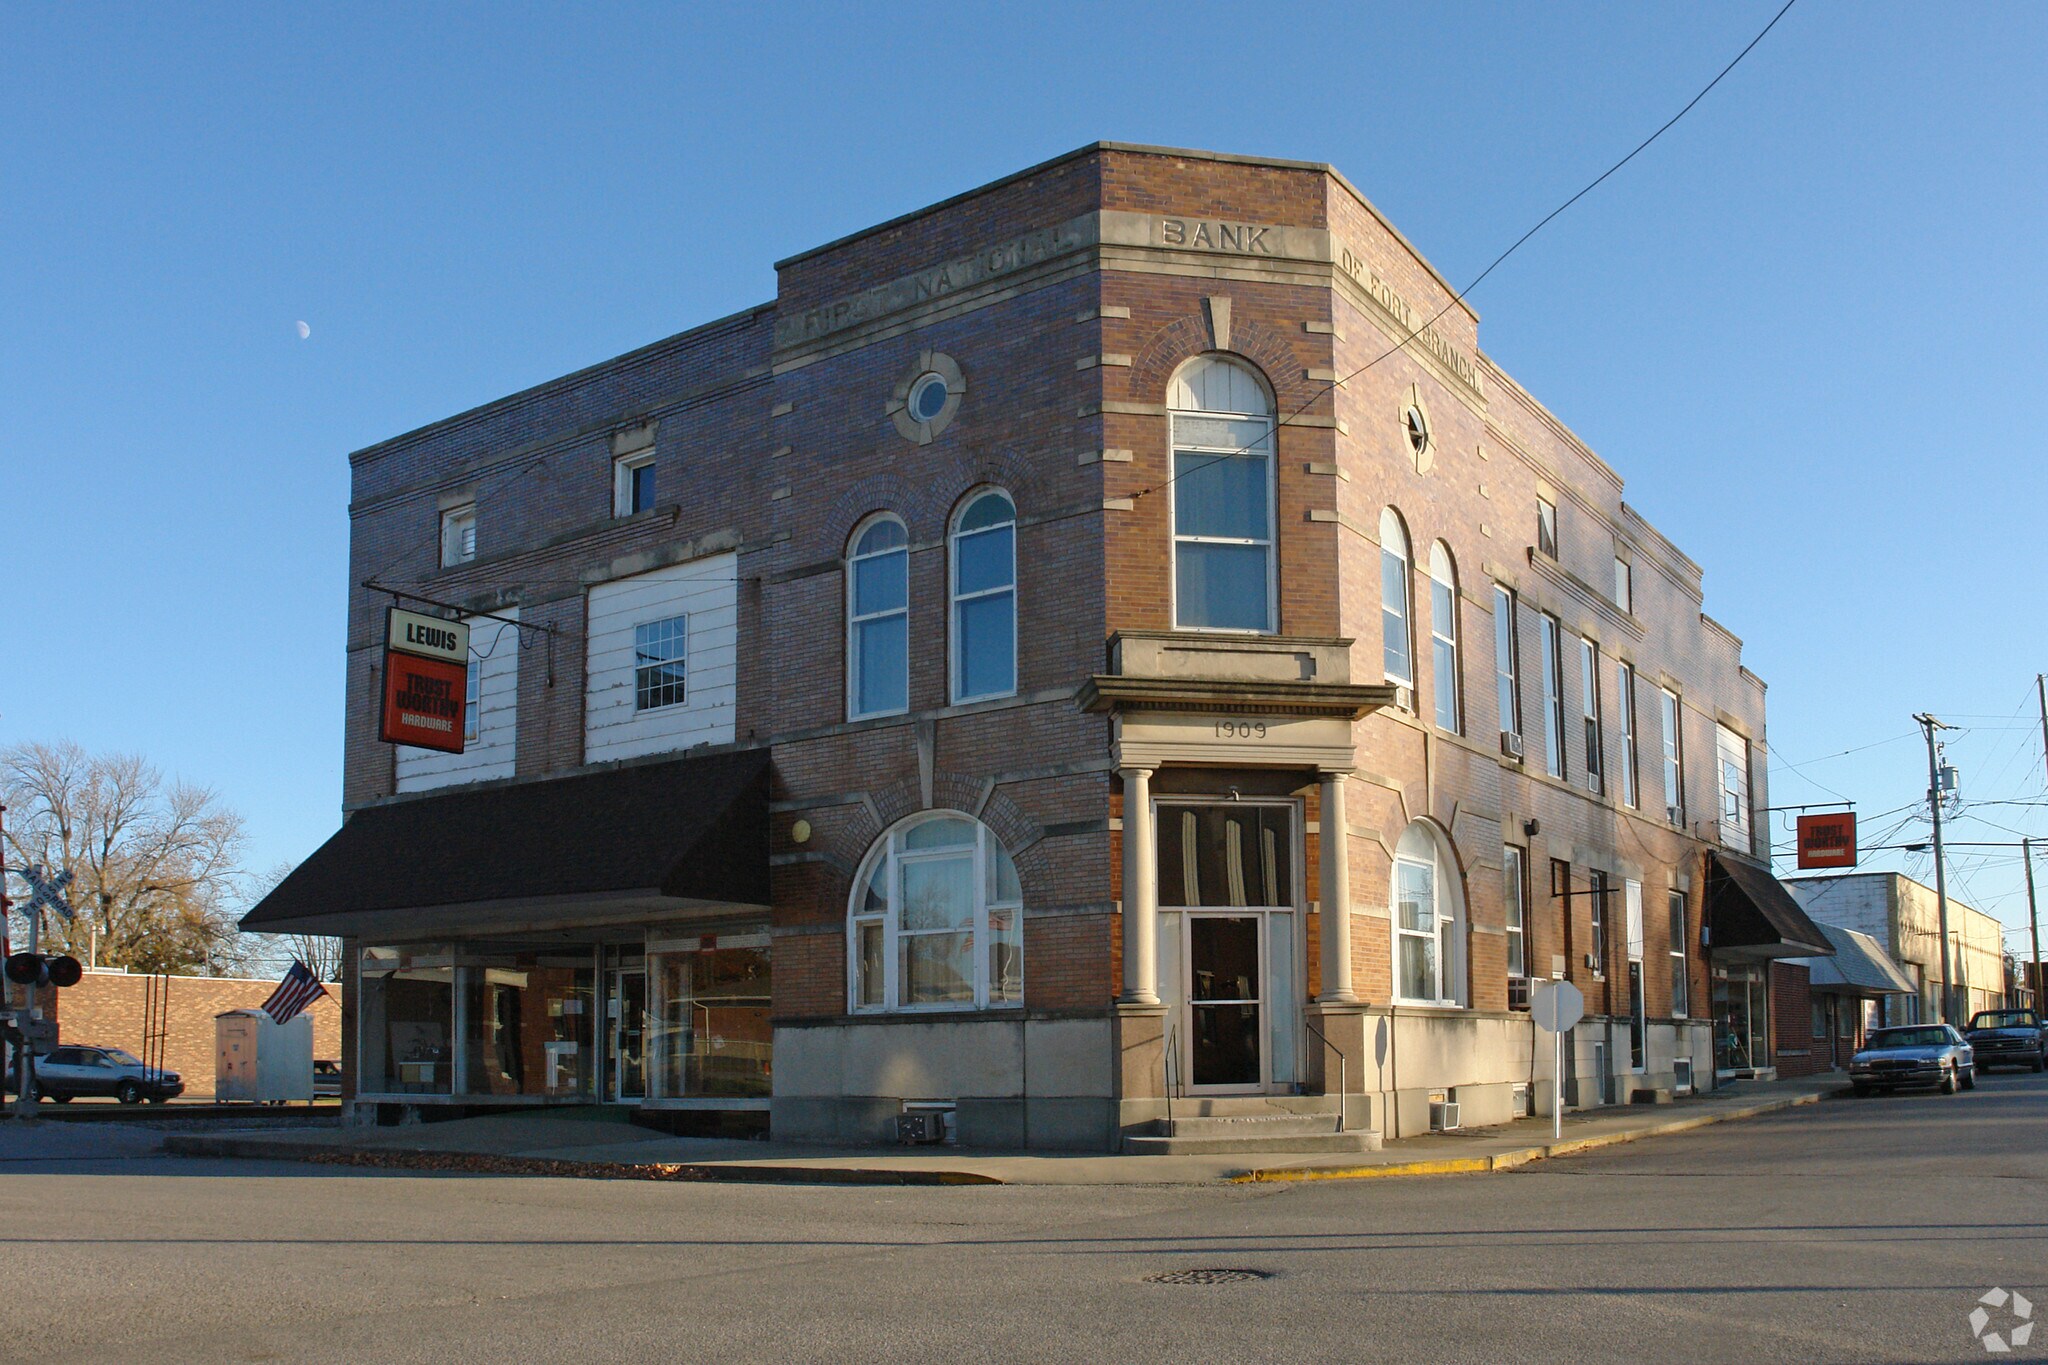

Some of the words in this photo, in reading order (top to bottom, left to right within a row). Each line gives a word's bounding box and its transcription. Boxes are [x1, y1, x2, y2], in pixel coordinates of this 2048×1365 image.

[1162, 219, 1271, 254] BANK
[1342, 248, 1363, 281] OF
[1370, 271, 1411, 329] FORT
[407, 623, 457, 651] LEWIS
[407, 673, 452, 699] TRUST
[397, 690, 458, 717] WORTHY
[401, 712, 454, 733] HARDWARE
[1215, 720, 1267, 739] 1909
